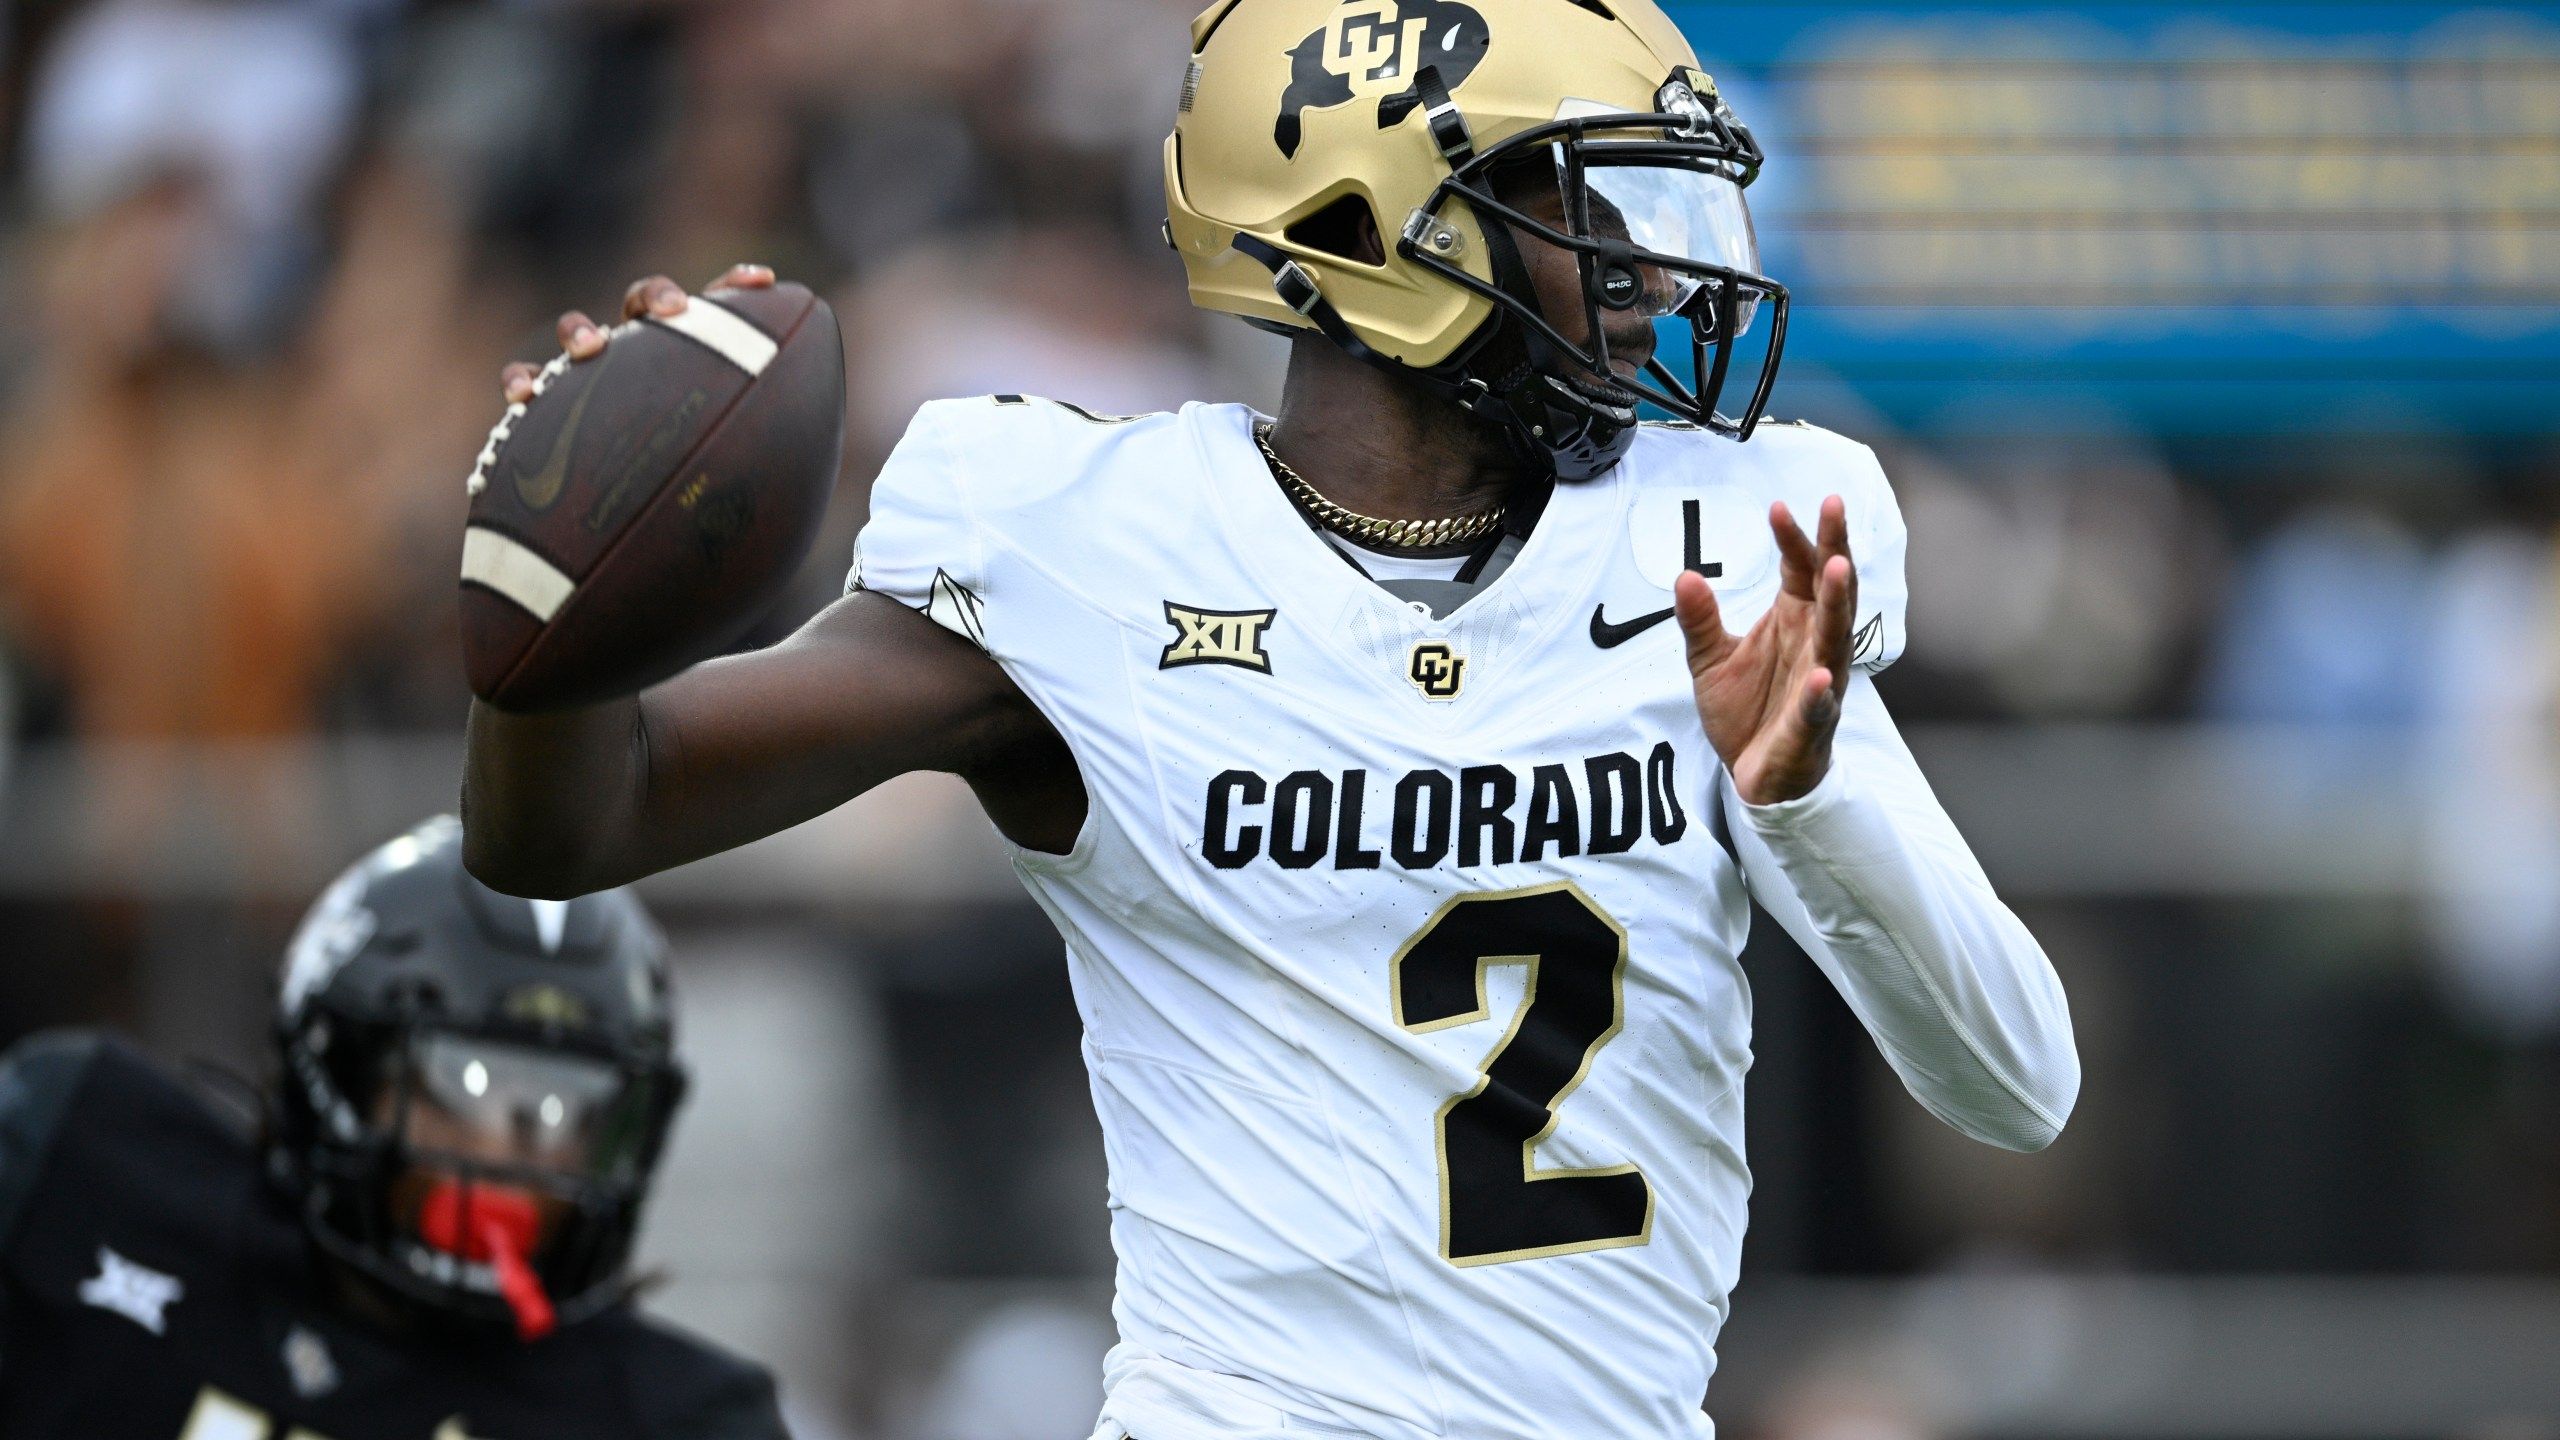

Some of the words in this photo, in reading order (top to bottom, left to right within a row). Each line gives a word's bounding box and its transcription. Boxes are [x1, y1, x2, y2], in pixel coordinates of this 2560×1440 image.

[1321, 0, 1428, 99] CU
[1682, 499, 1723, 579] L
[1162, 602, 1273, 671] XII
[1409, 643, 1466, 698] CU
[1201, 741, 1688, 871] COLORADO
[1389, 879, 1655, 1268] 2
